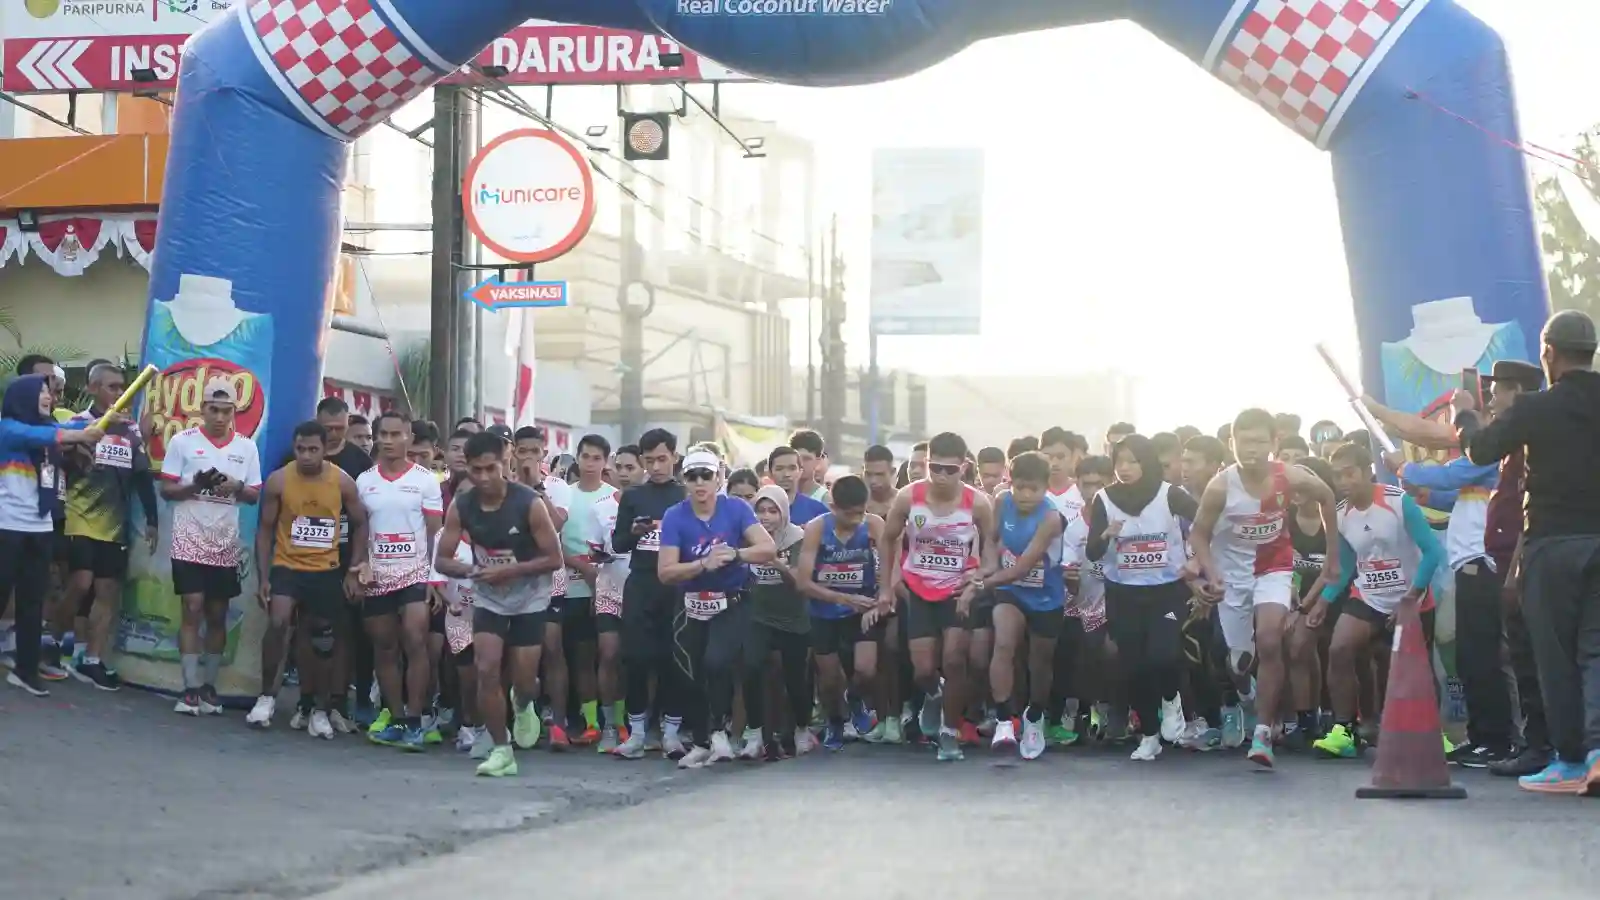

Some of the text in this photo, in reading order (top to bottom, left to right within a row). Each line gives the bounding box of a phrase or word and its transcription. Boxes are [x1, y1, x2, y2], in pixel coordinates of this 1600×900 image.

[63, 3, 145, 16] PARIPURNA
[676, 0, 890, 14] Real Coconut Water
[489, 286, 562, 301] VAKSINASI
[100, 444, 130, 457] 32584
[296, 526, 329, 537] 32375
[377, 543, 412, 553] 32290
[919, 554, 958, 567] 32033
[1123, 553, 1163, 564] 32609
[824, 572, 858, 581] 32016
[1365, 570, 1400, 583] 32555
[690, 599, 721, 611] 32541
